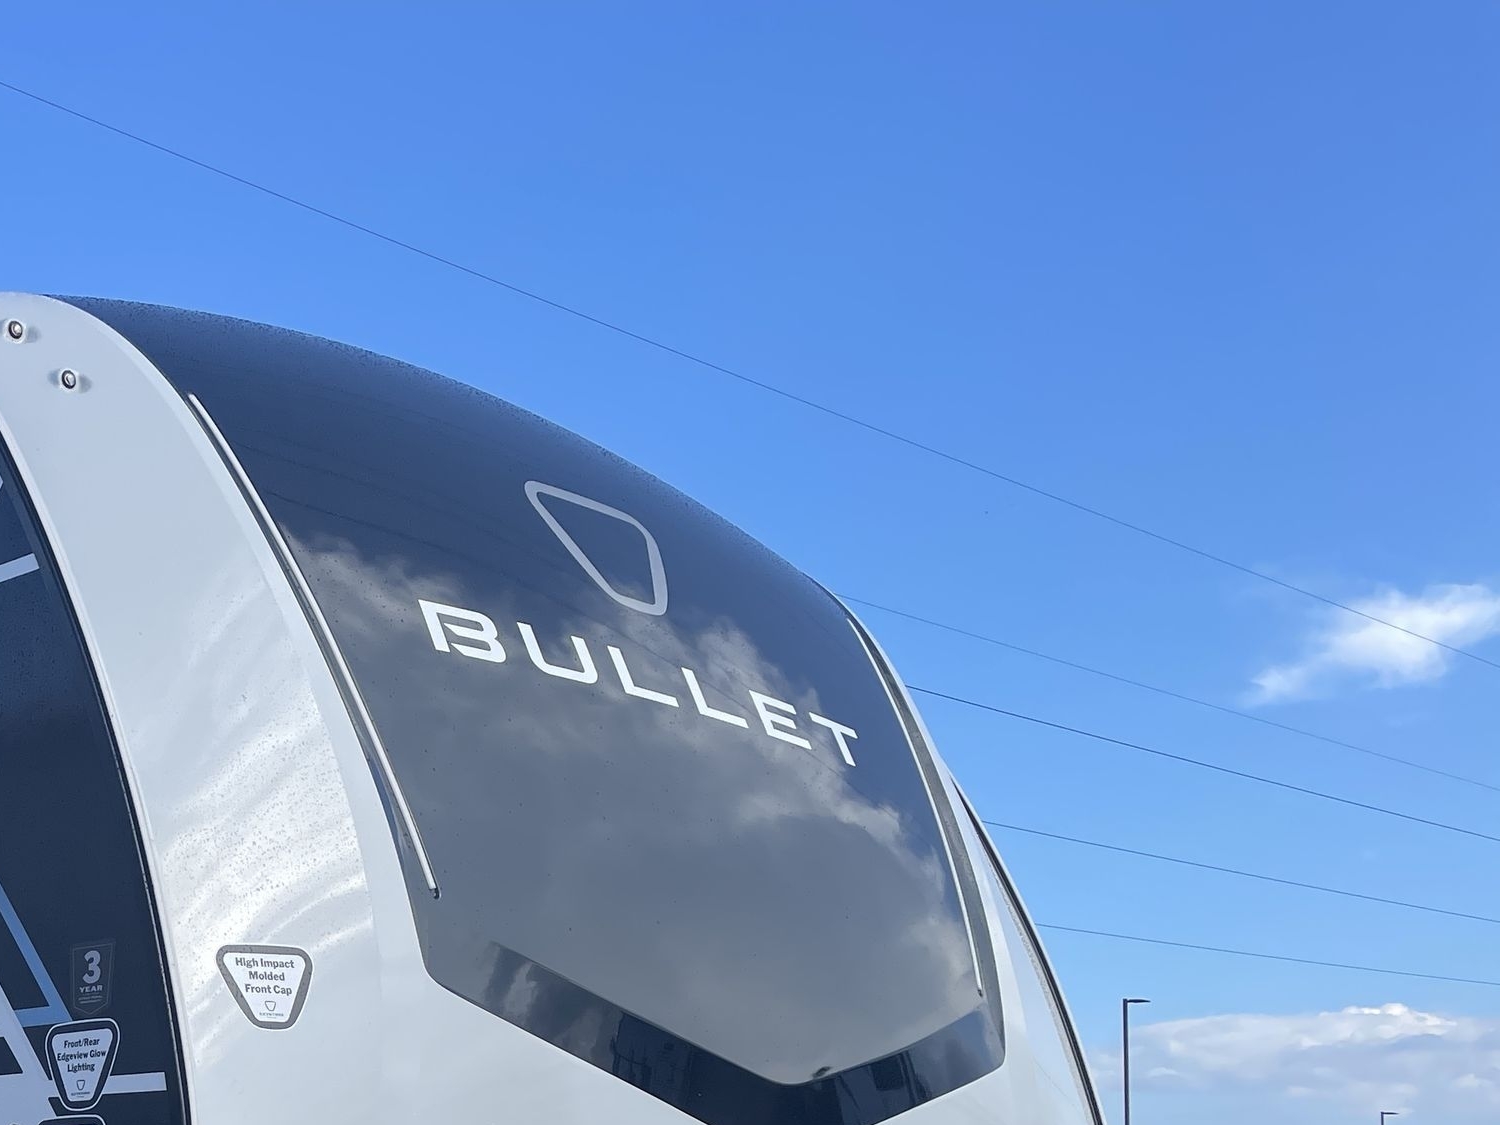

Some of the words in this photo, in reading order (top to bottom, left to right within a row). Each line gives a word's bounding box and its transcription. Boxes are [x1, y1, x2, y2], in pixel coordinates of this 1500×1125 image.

[417, 599, 858, 767] BULLET
[82, 950, 101, 984] 3
[235, 957, 259, 969] High
[260, 958, 295, 969] Impact
[248, 970, 285, 981] Molded
[79, 985, 103, 993] YEAR
[244, 983, 272, 993] Front
[273, 984, 293, 996] Cap
[63, 1038, 100, 1048] Front/Rear
[57, 1051, 89, 1062] Edgeview
[67, 1063, 95, 1073] Lighting
